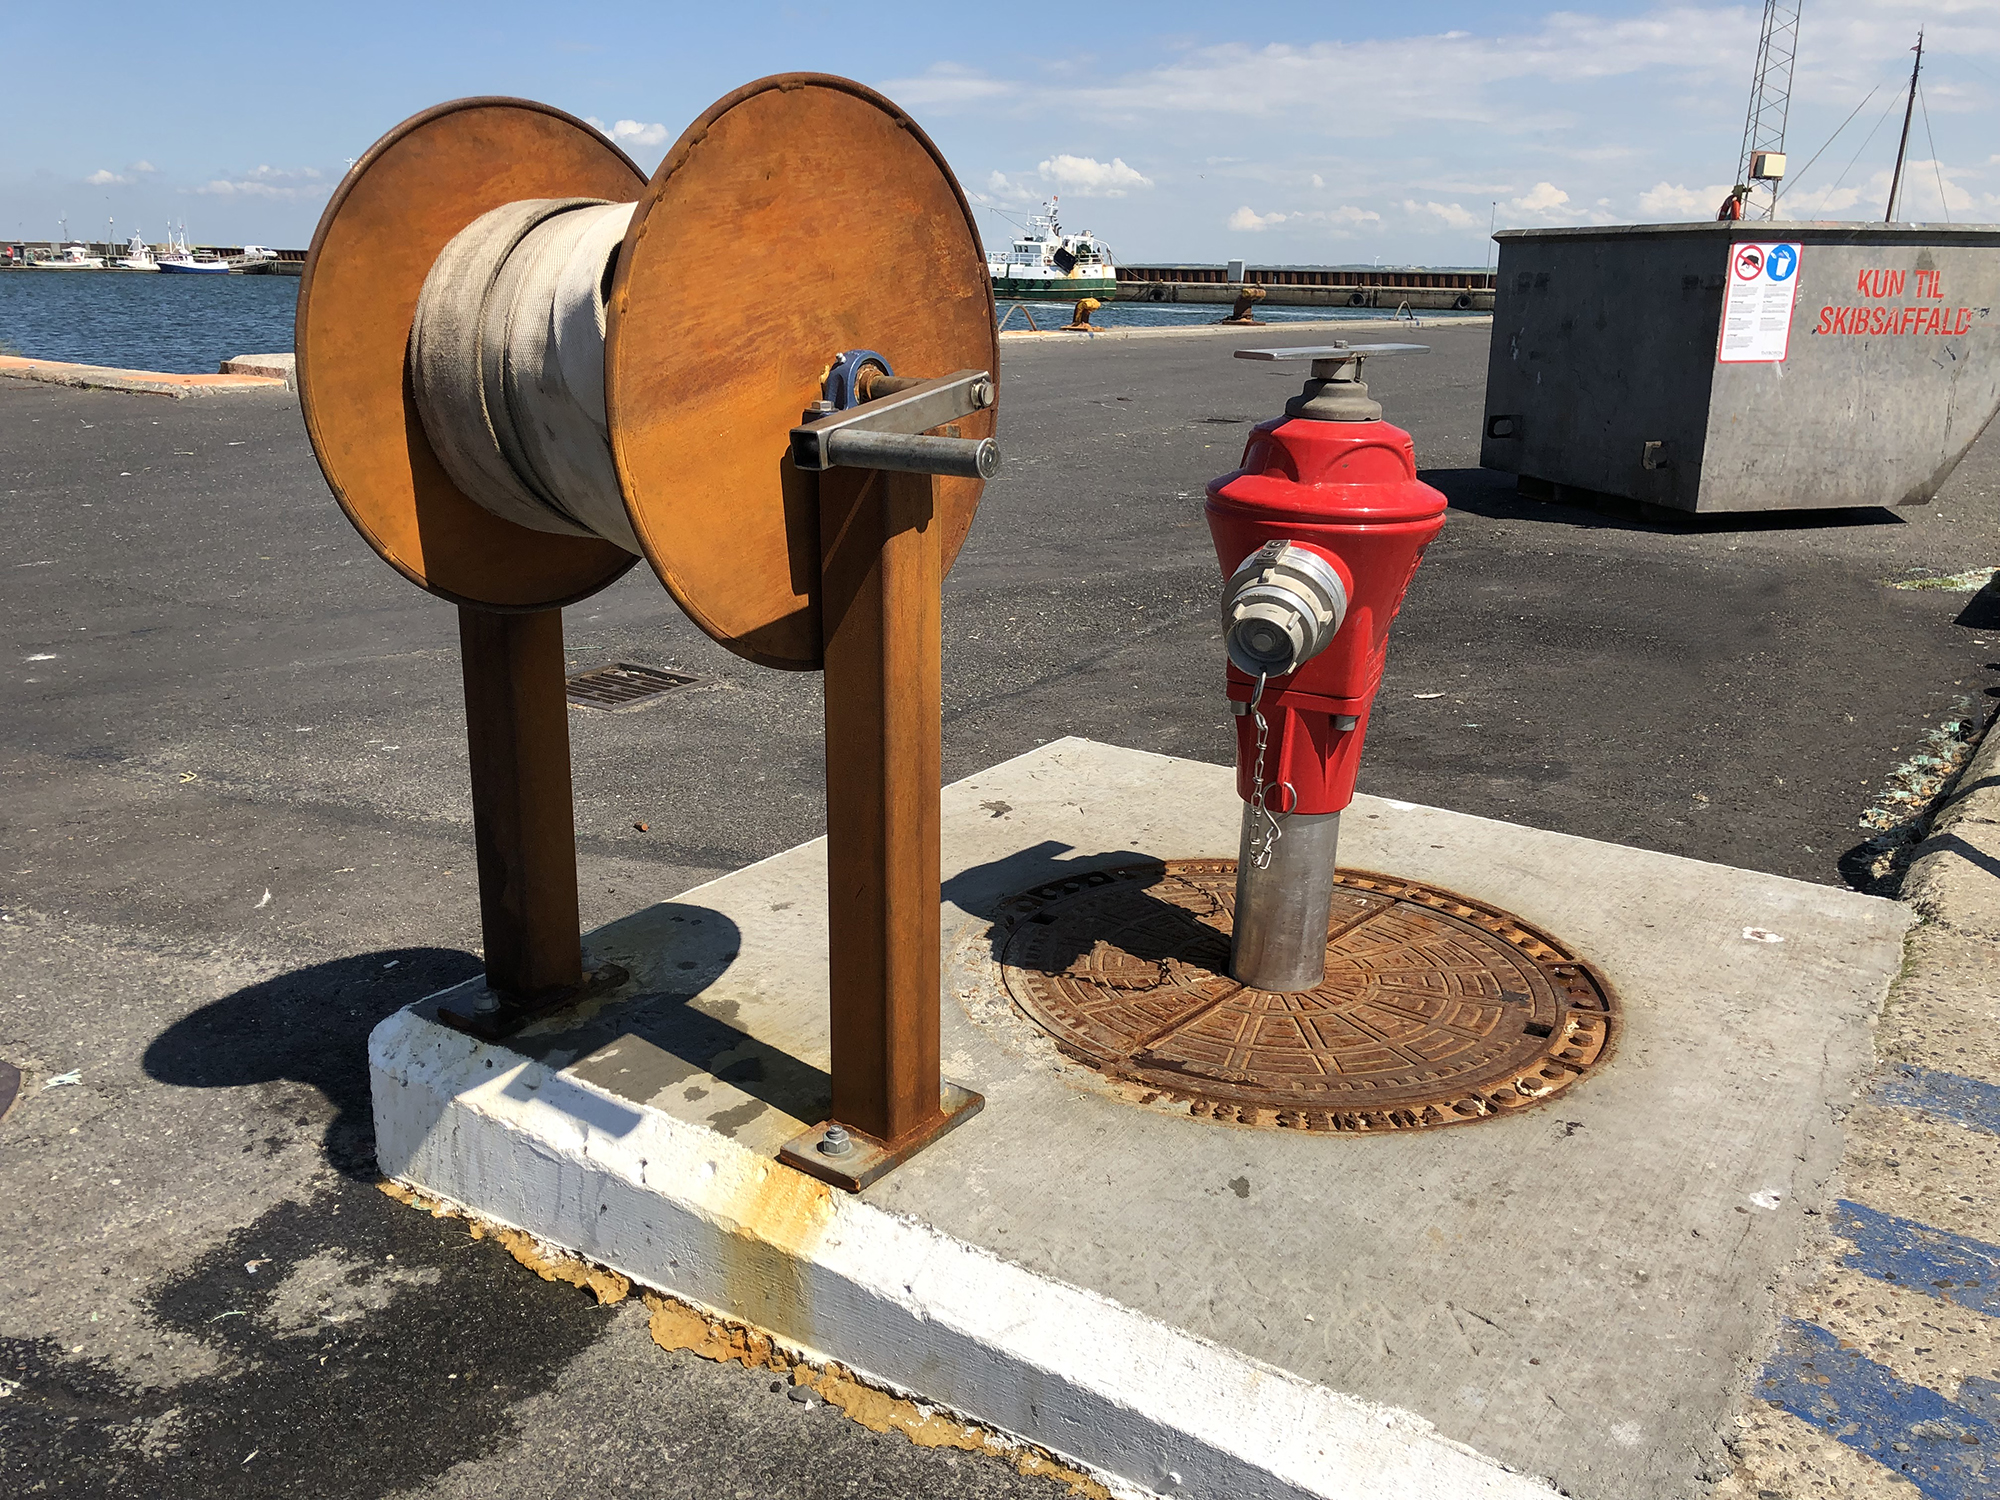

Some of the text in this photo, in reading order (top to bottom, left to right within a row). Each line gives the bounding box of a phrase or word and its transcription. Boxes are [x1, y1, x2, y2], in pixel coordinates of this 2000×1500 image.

[1857, 269, 1945, 299] KUN TIL
[1817, 306, 1972, 336] SKIBSAFFALD
